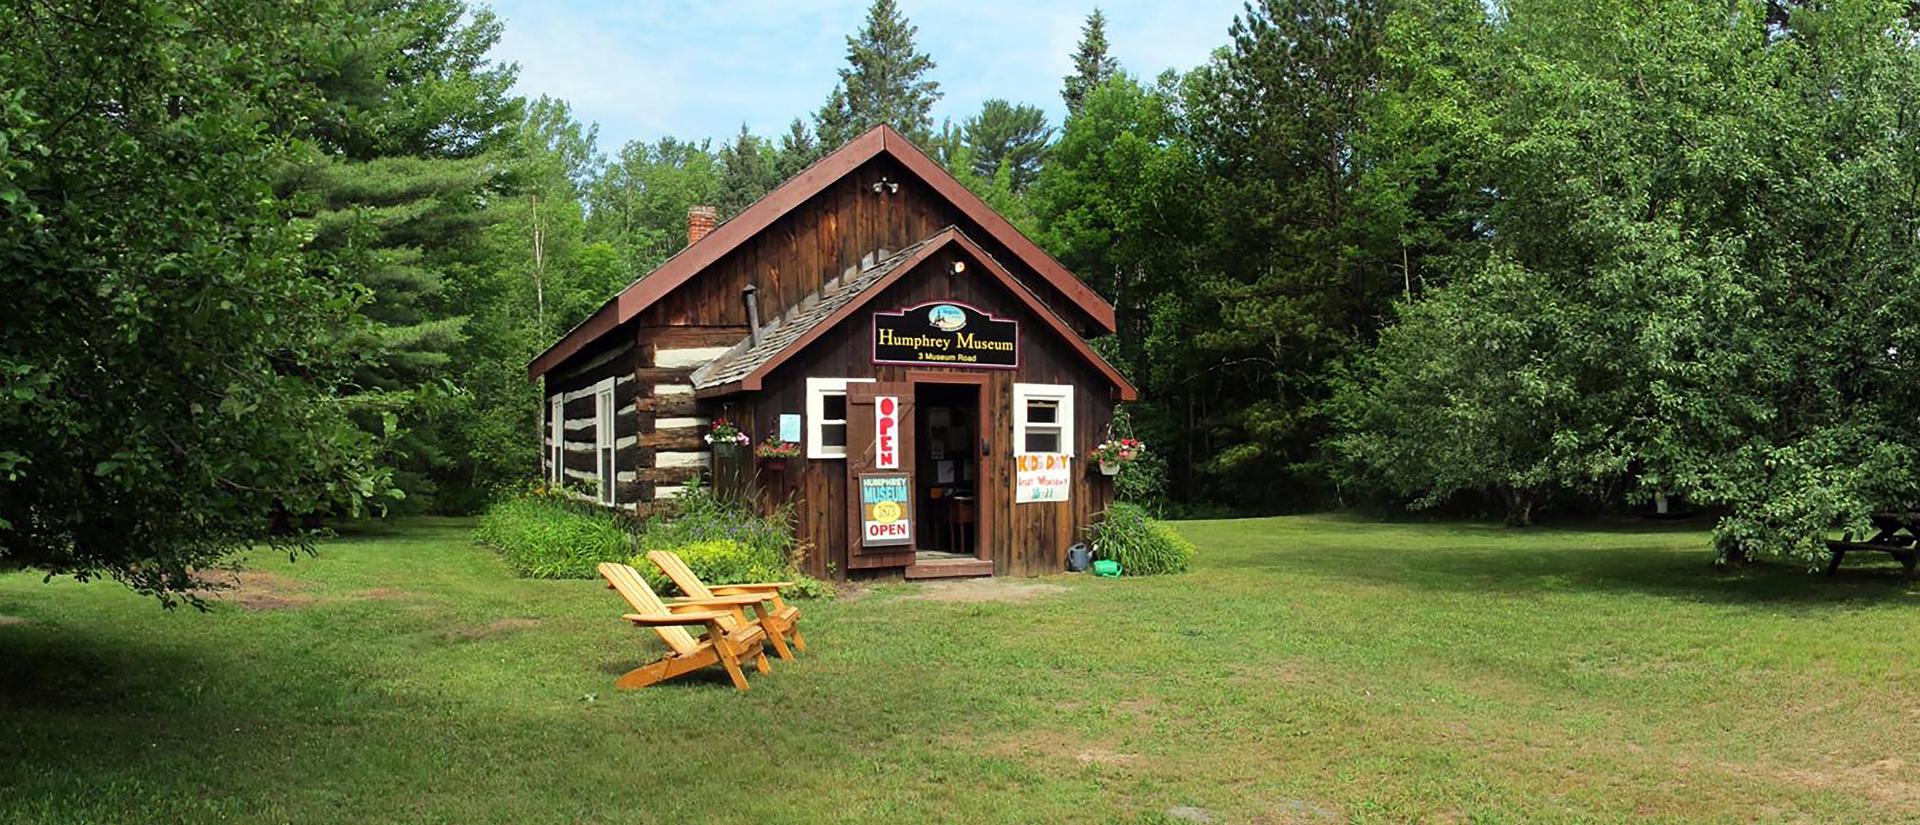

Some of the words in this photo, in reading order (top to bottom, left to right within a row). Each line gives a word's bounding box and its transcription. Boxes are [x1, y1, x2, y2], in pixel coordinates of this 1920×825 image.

[878, 328, 952, 351] Humphrey
[956, 332, 1014, 352] Museum
[918, 352, 923, 360] 3
[925, 352, 956, 361] Museum
[958, 354, 977, 362] Road
[879, 398, 894, 466] OPEN
[863, 478, 907, 487] HUMPHREY
[864, 486, 907, 503] MUSEUM
[869, 524, 906, 537] OPEN
